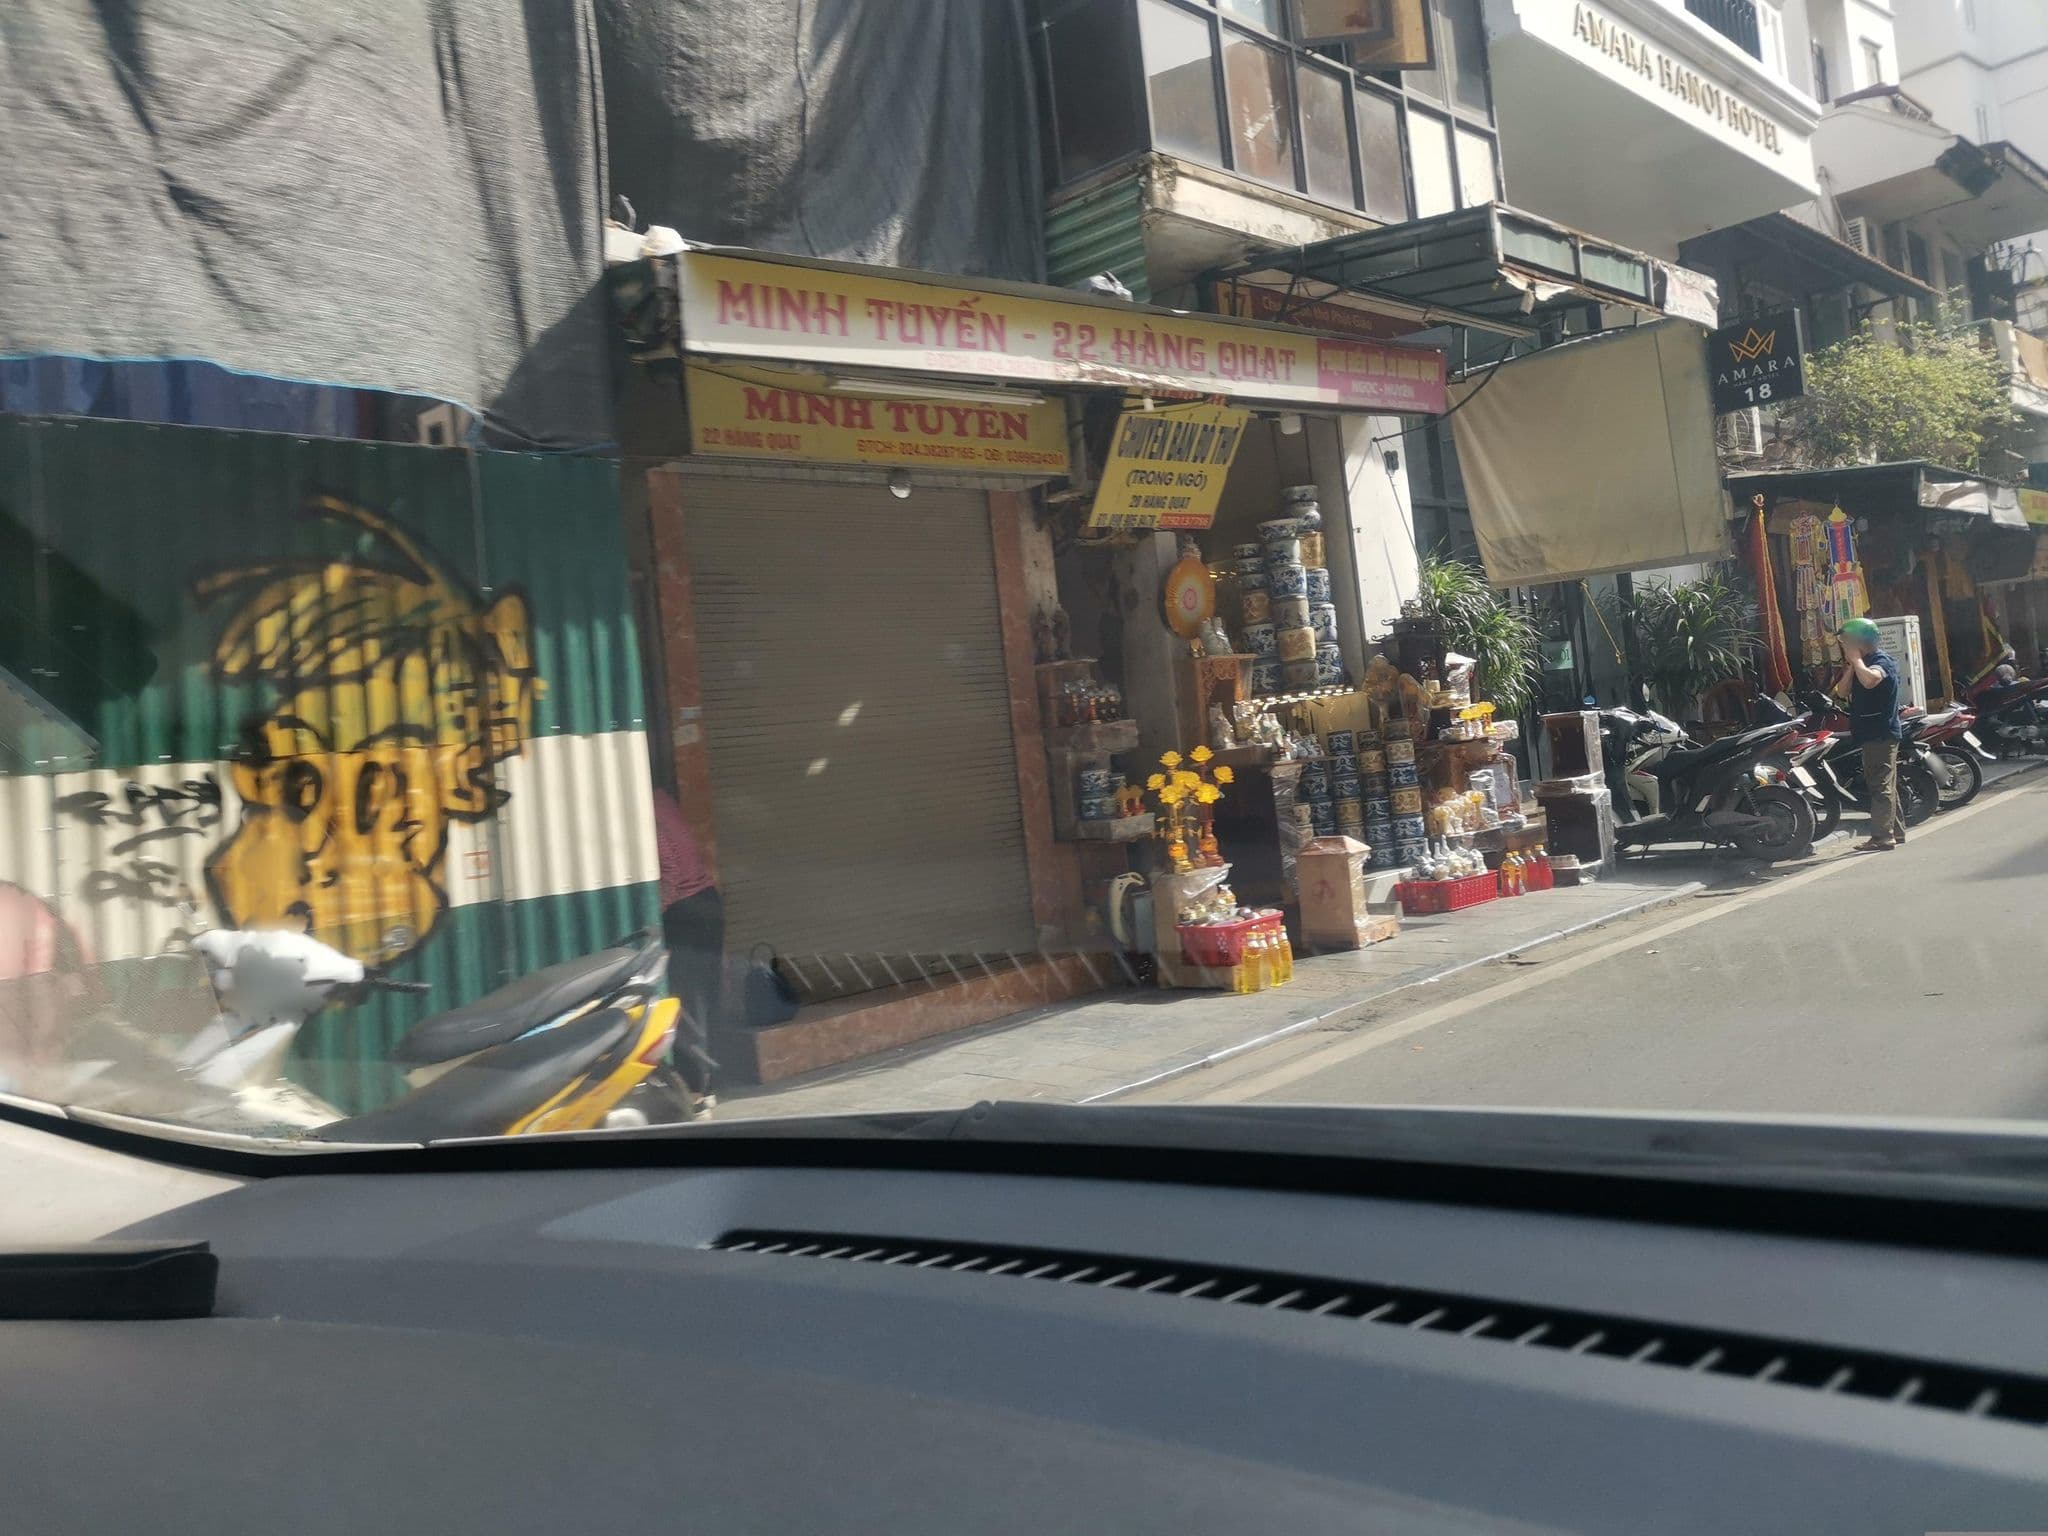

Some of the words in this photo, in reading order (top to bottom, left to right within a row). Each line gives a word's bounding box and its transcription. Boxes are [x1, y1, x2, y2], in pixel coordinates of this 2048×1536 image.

[1574, 3, 1653, 80] AMARA
[1657, 54, 1722, 121] HANOI
[1725, 95, 1783, 155] HOTEL
[716, 279, 849, 337] MINH
[1052, 320, 1097, 362] 22
[1111, 323, 1207, 373] HÀNG
[1718, 356, 1795, 385] AMARA
[743, 387, 874, 430] MINH
[1745, 383, 1772, 402] 18
[1126, 468, 1173, 487] (TRONG
